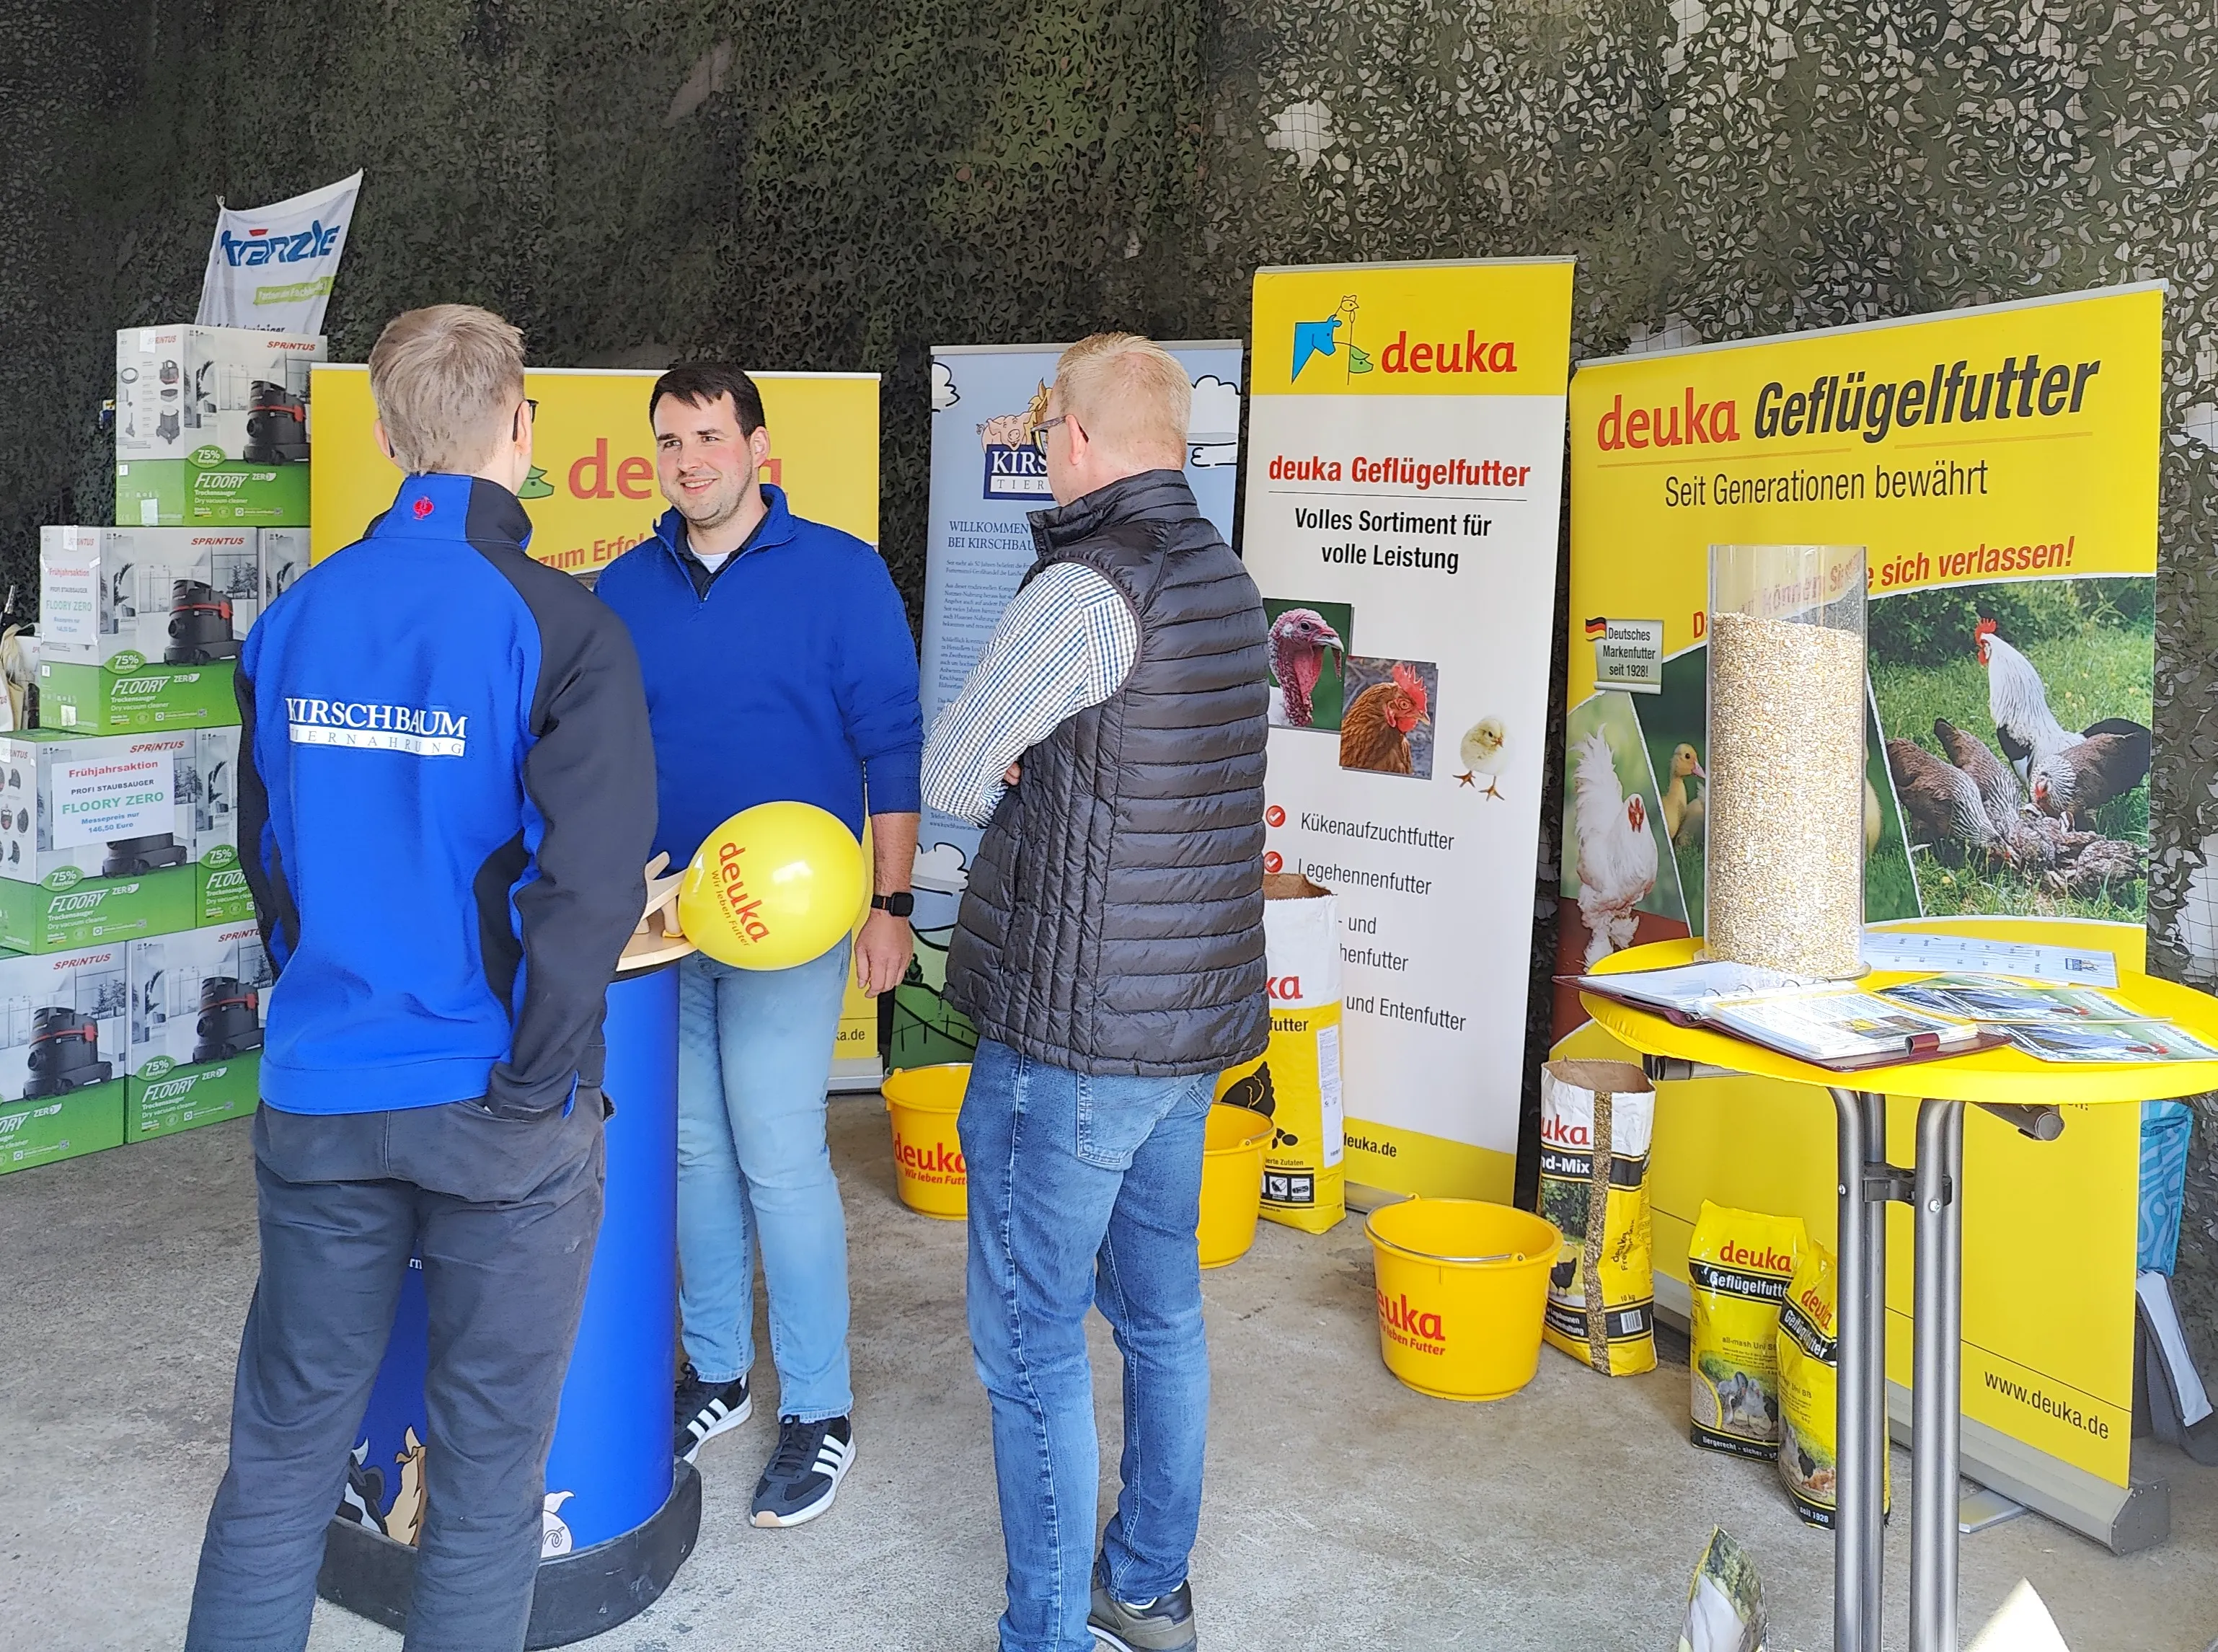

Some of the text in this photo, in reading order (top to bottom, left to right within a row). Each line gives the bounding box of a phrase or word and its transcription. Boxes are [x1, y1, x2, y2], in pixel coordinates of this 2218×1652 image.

[1381, 330, 1518, 374] deuka
[1597, 354, 2101, 451] deuka Geflügelfutter
[198, 449, 221, 459] 75%
[194, 472, 250, 489] FLOORY
[1268, 454, 1531, 491] deuka Geflügelfutter
[1665, 459, 1988, 507] Seit Generationen bewährt
[949, 521, 1029, 534] WILLKOMMEN
[1295, 508, 1492, 537] Volles Sortiment für
[947, 536, 966, 548] BEI
[1321, 543, 1459, 575] volle Leistung
[1881, 552, 1930, 587] sich
[1938, 535, 2076, 578] verlassen!
[1608, 627, 1651, 642] Deutsches
[115, 654, 139, 664] 75%
[1602, 645, 1656, 661] Markenfutter
[1609, 665, 1649, 678] seit 1928!
[110, 676, 172, 696] FLOORY
[285, 697, 469, 738] KIRSCHBAUM
[69, 761, 159, 778] Frühjahrsaktion
[71, 779, 155, 795] PROFI STAUBSAUGER
[62, 792, 164, 815] FLOORY ZERO
[81, 813, 126, 825] Messepreis
[88, 824, 115, 834] 146,50
[1300, 812, 1455, 851] Kükenaufzuchtfutter
[210, 849, 232, 860] 75%
[52, 870, 77, 882] 75%
[47, 888, 110, 914] FLOORY
[719, 842, 770, 943] deuka
[711, 870, 751, 947] Wir leben Futter
[1348, 916, 1377, 935] und
[1346, 995, 1467, 1031] und Entenfutter
[146, 1059, 169, 1073] 75%
[141, 1074, 200, 1103] FLOORY
[905, 1167, 916, 1180] Wir
[917, 1171, 942, 1185] leben
[1719, 1240, 1792, 1273] deuka
[1410, 1337, 1446, 1356] Futter
[1984, 1371, 2109, 1440] www.deuka.de
[1742, 1446, 1762, 1457] sicher
[1812, 1510, 1829, 1524] 1928
